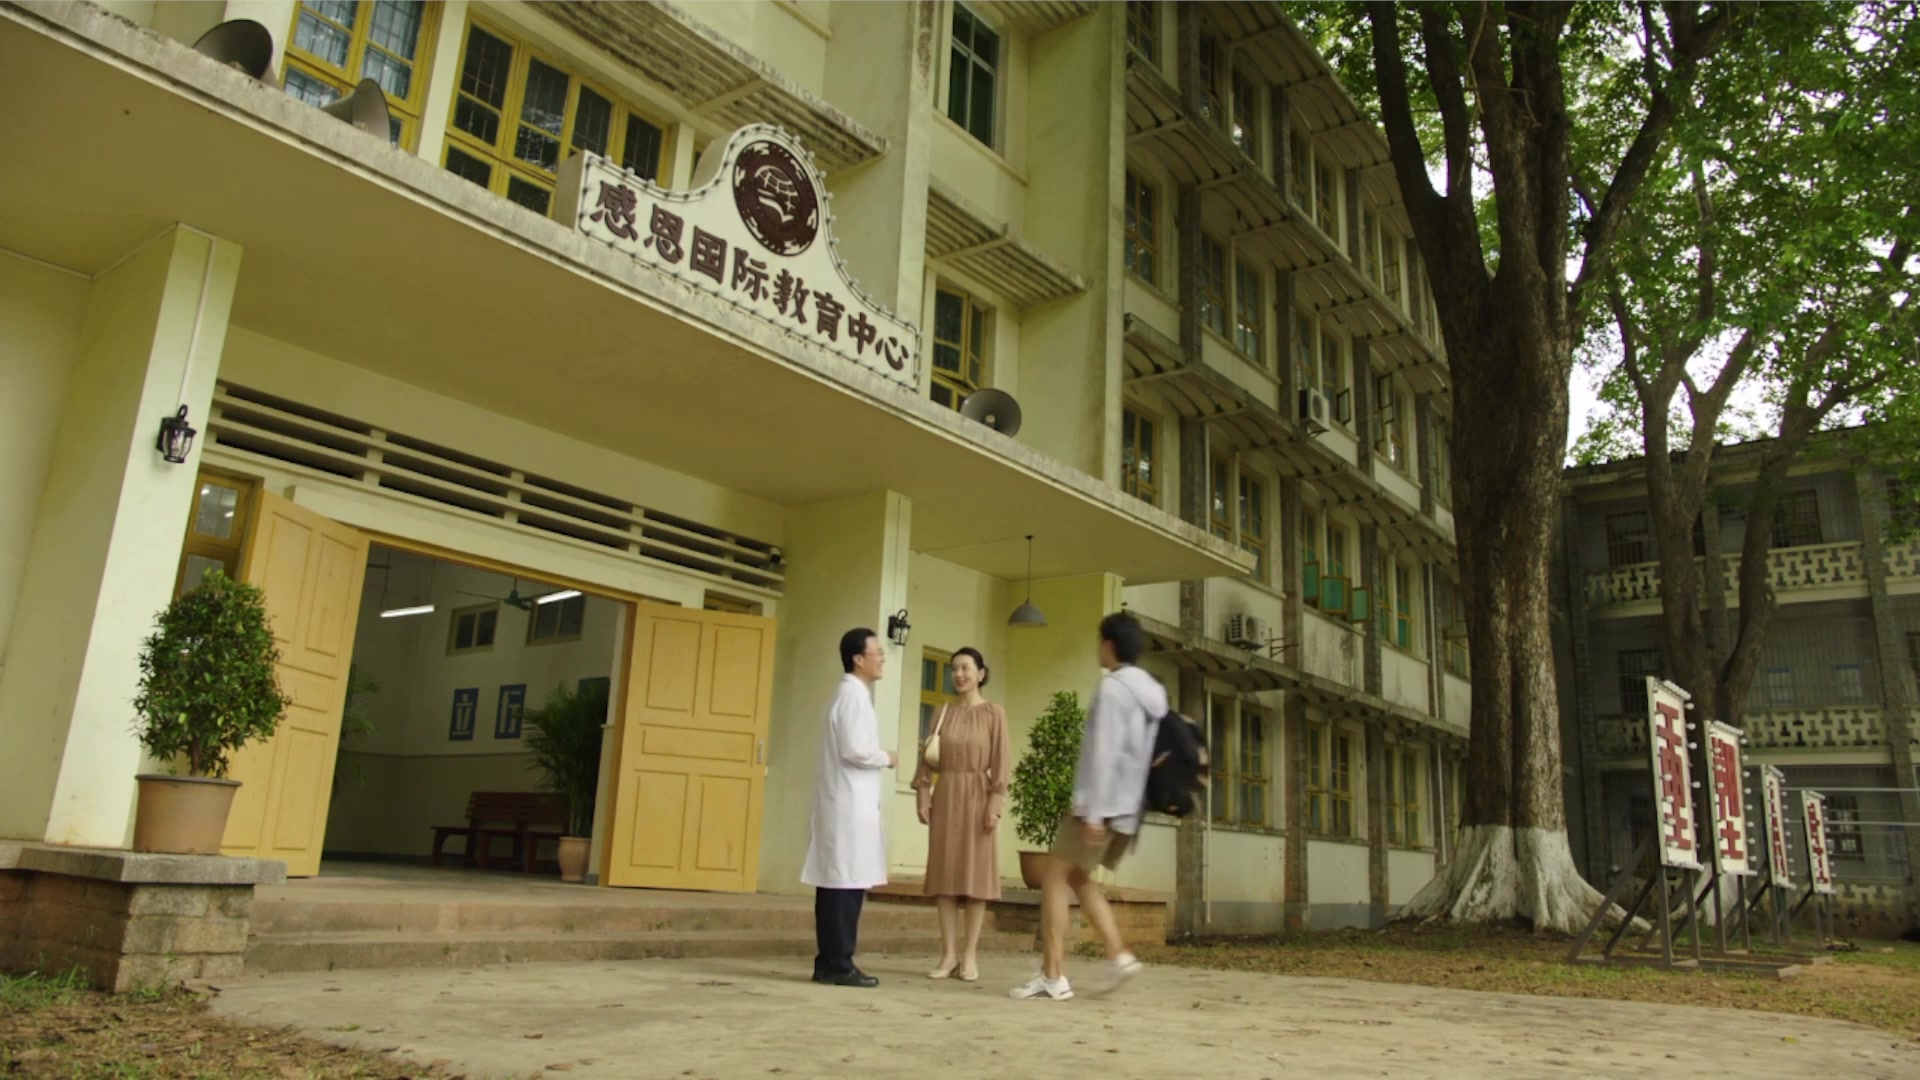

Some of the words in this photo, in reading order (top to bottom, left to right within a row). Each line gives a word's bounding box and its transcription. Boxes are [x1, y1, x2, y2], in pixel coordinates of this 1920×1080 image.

[590, 180, 909, 371] 感恩国际教育中心
